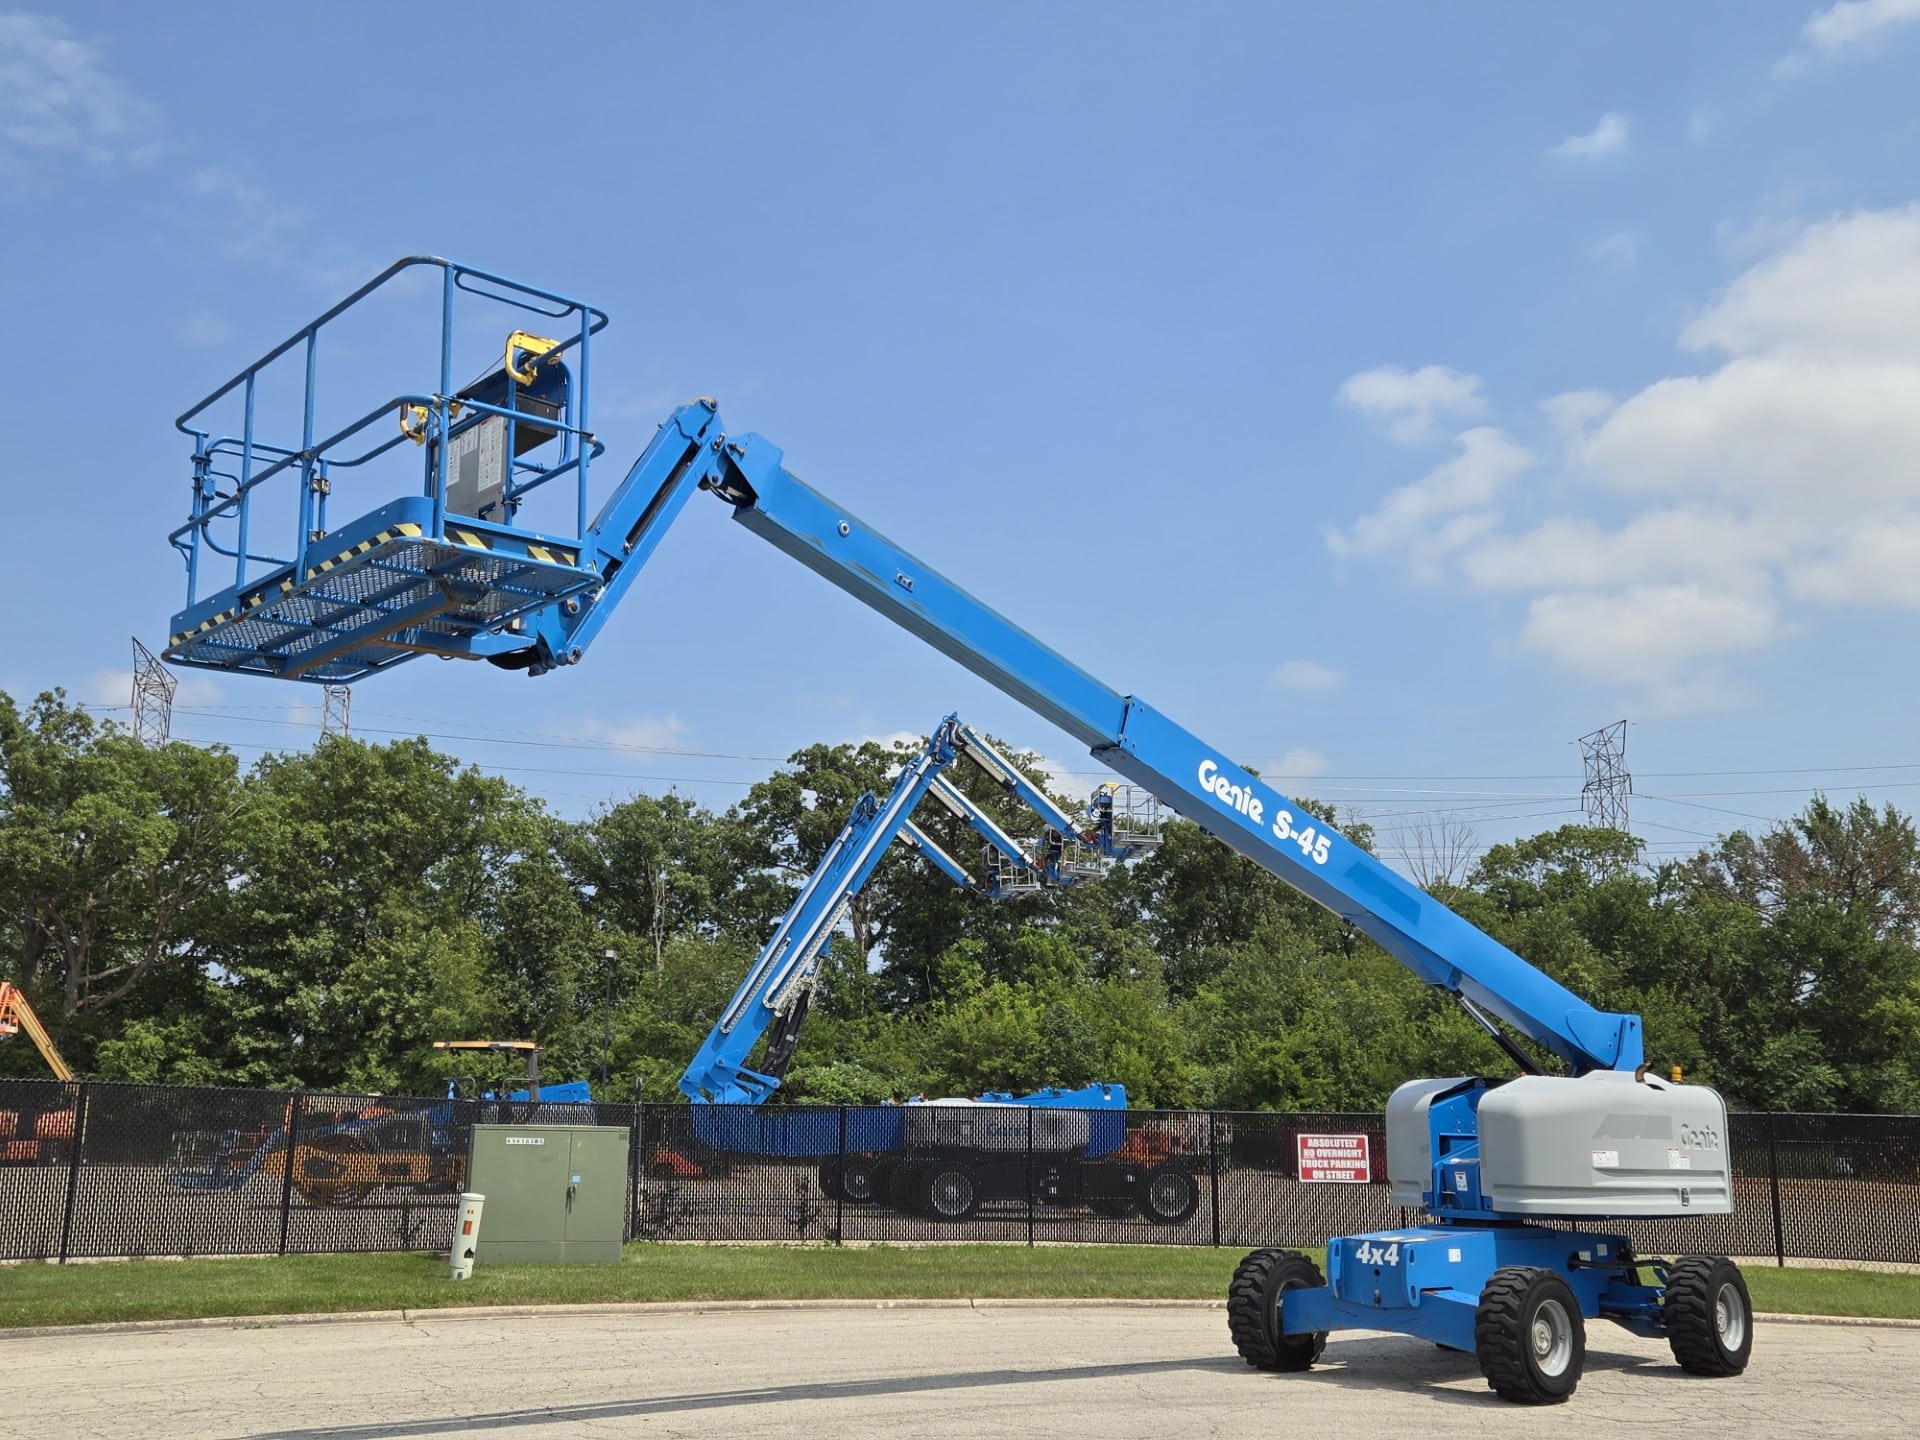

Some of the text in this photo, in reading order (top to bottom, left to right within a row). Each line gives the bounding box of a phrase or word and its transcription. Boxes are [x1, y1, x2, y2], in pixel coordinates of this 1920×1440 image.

[1198, 759, 1331, 865] Genie S-45
[1681, 1123, 1719, 1150] Genie
[1307, 1138, 1358, 1148] ABSOLUTELY
[1303, 1148, 1363, 1158] NO OVERNIGHT
[1301, 1159, 1368, 1169] TRUCK PARKING
[1312, 1169, 1356, 1179] ON STREET
[1355, 1241, 1400, 1266] 4x4
